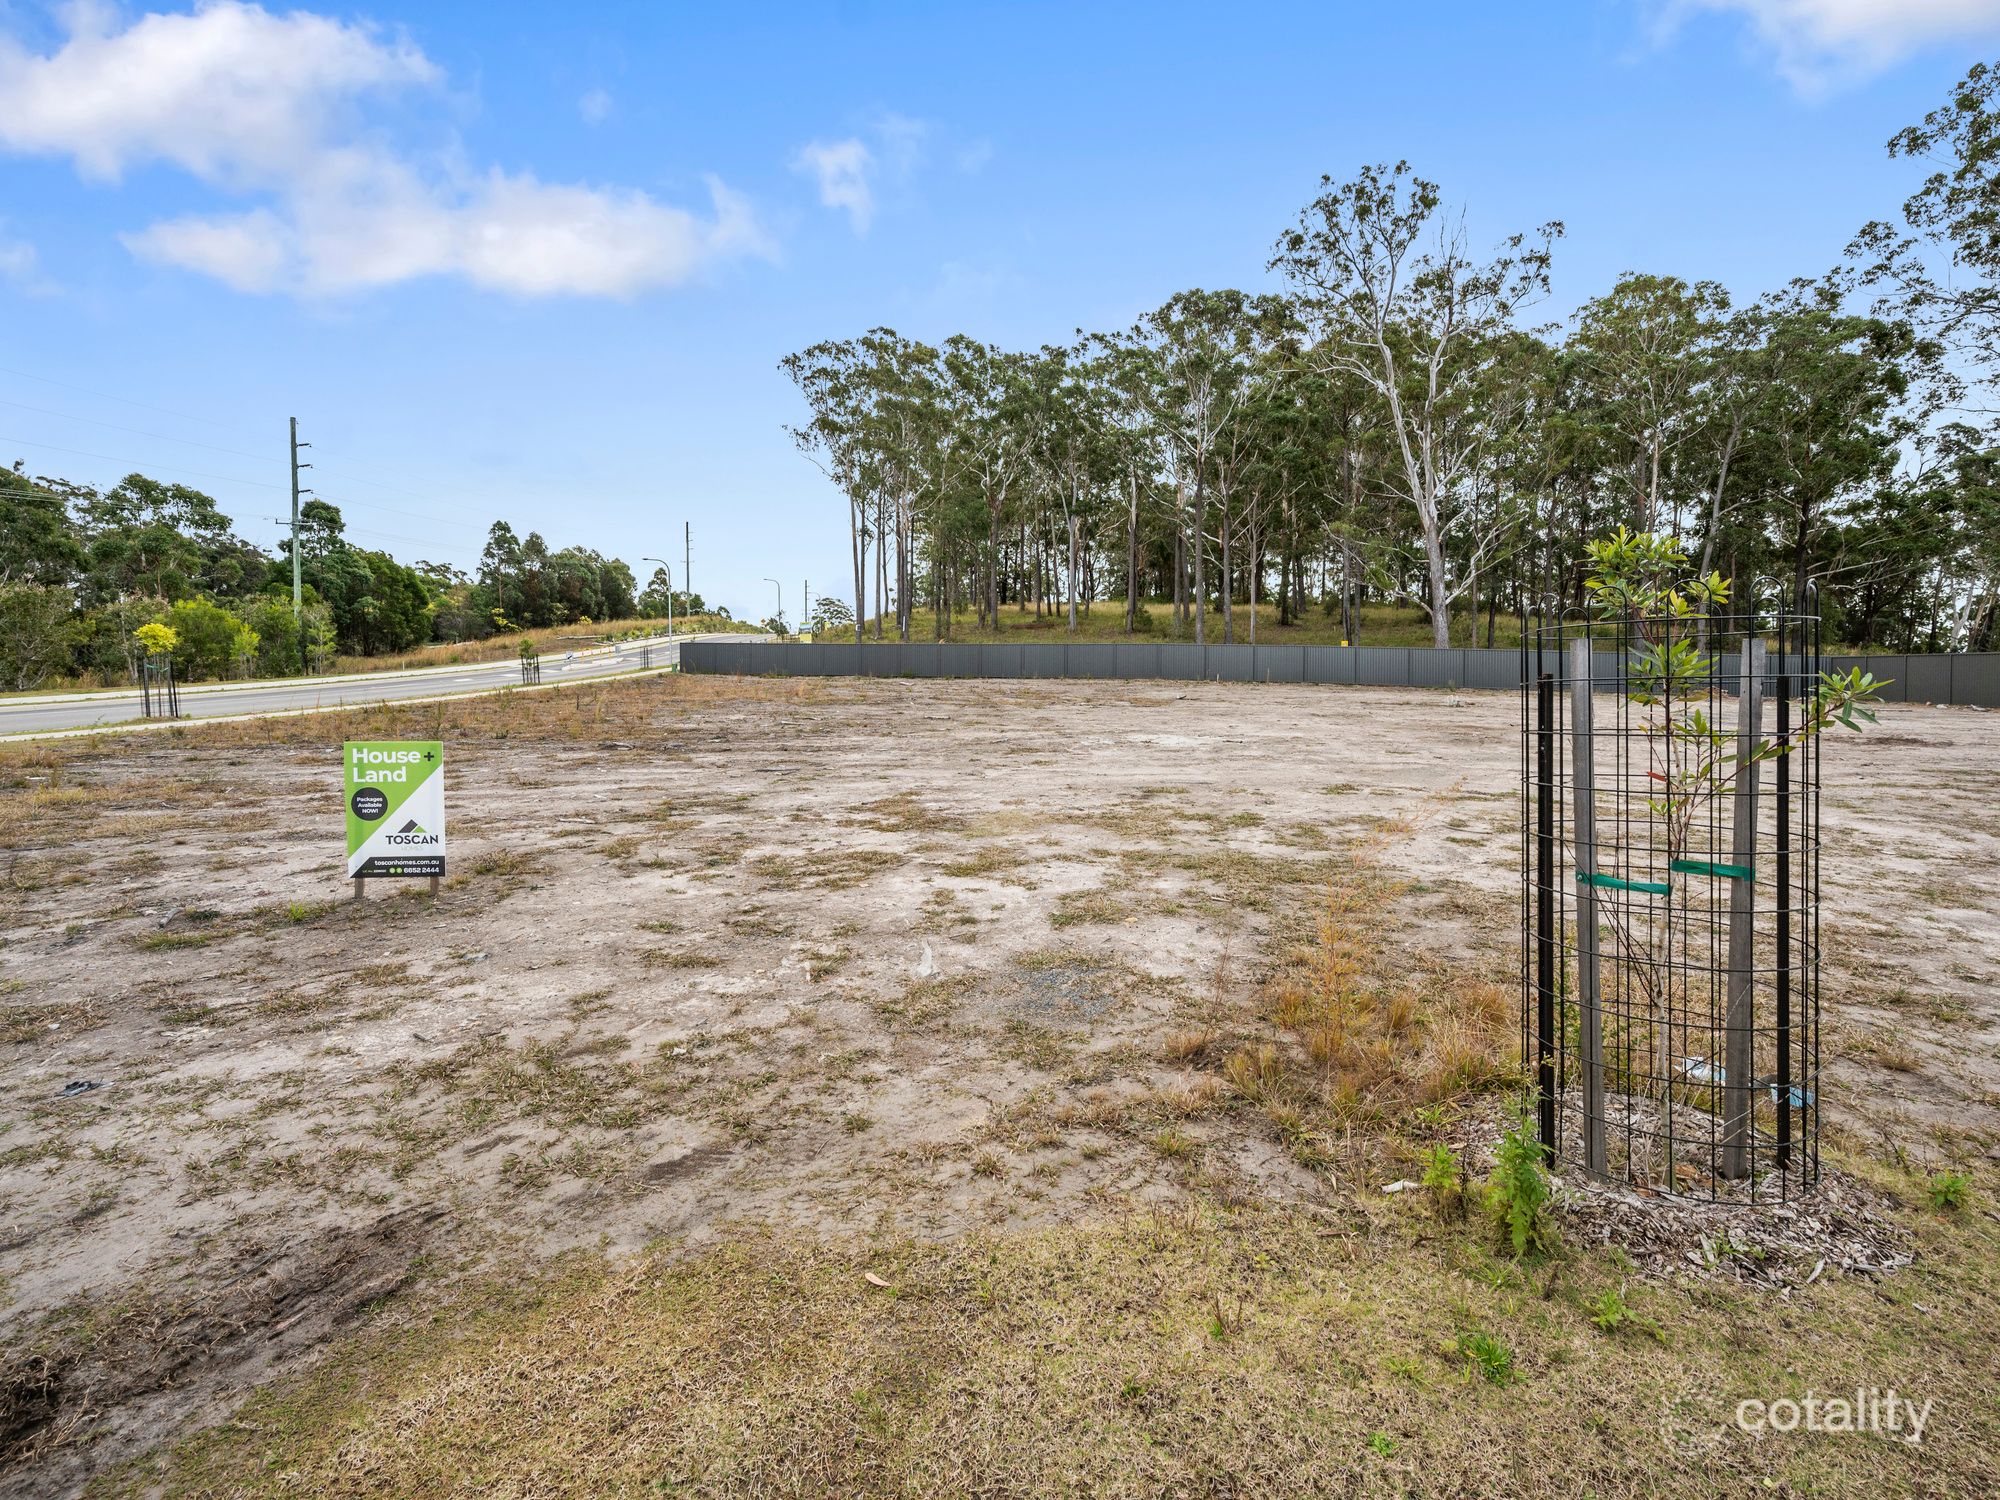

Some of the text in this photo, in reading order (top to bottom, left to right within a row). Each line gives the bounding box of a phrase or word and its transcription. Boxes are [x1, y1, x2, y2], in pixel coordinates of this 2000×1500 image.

[352, 748, 421, 764] House
[353, 766, 407, 783] Land
[386, 835, 439, 845] TOSCAN
